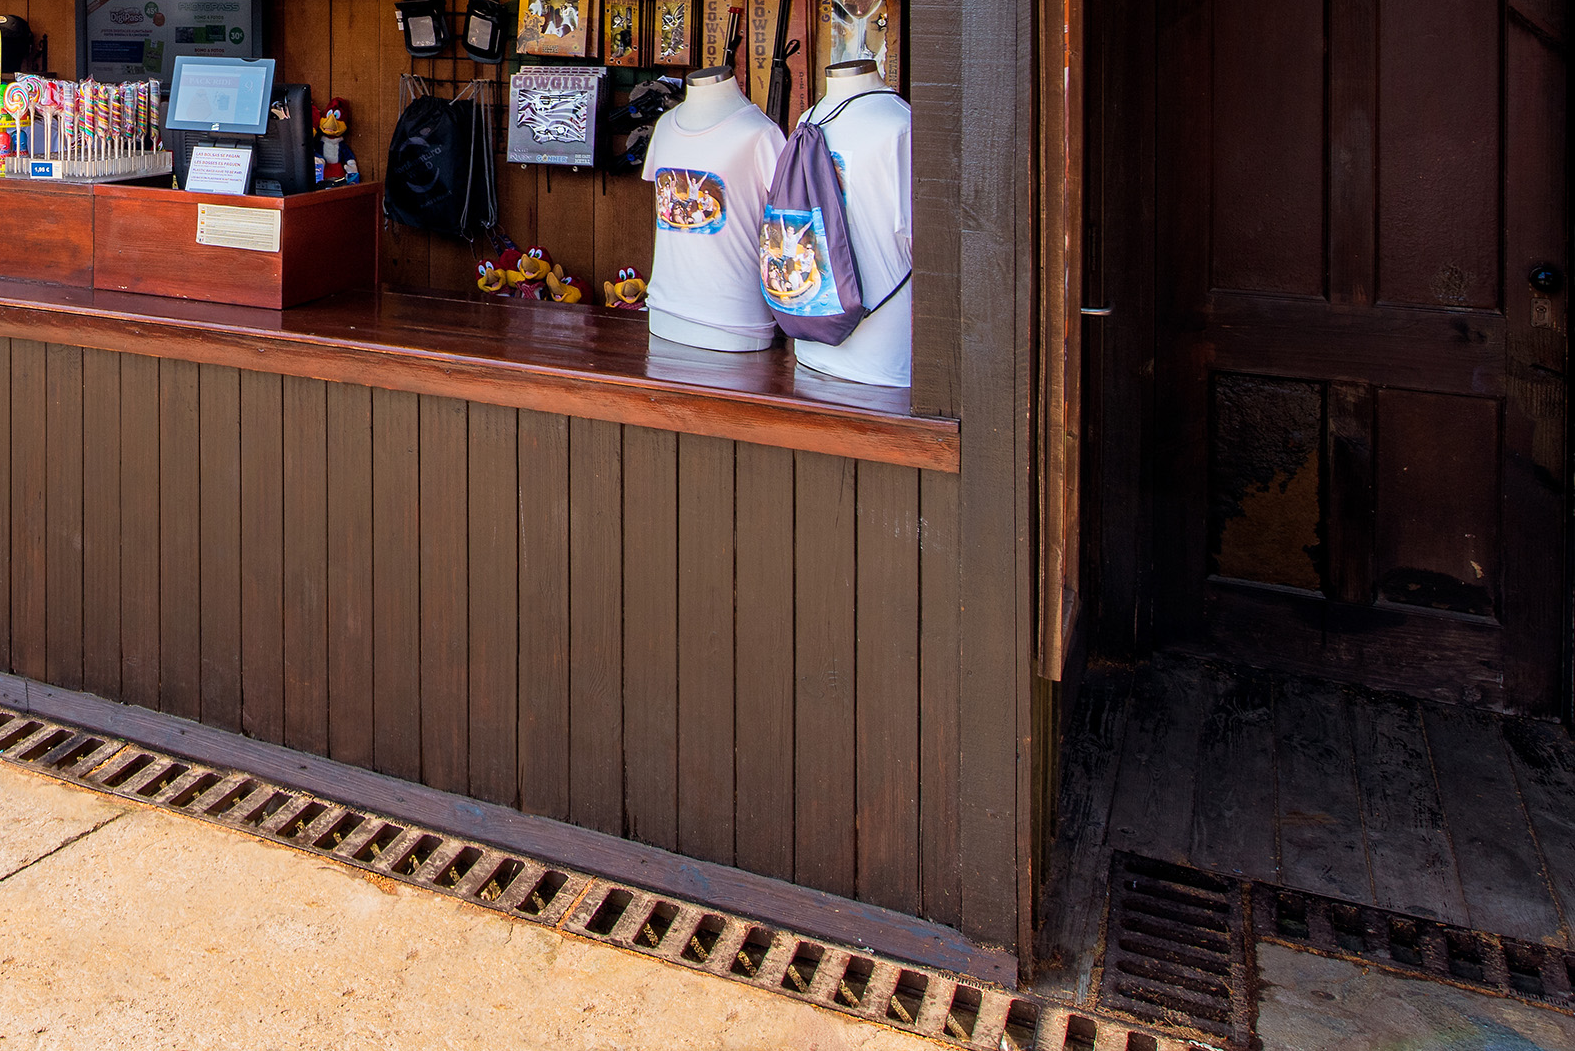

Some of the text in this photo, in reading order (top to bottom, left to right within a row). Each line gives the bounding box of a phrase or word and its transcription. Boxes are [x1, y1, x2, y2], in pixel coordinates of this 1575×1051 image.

[178, 2, 240, 11] PHOTOPASS
[110, 12, 144, 24] DigiPass
[705, 1, 719, 68] COWBOY
[888, 53, 898, 83] METAL
[511, 76, 595, 90] COWGIRL
[536, 154, 568, 163] GONHER
